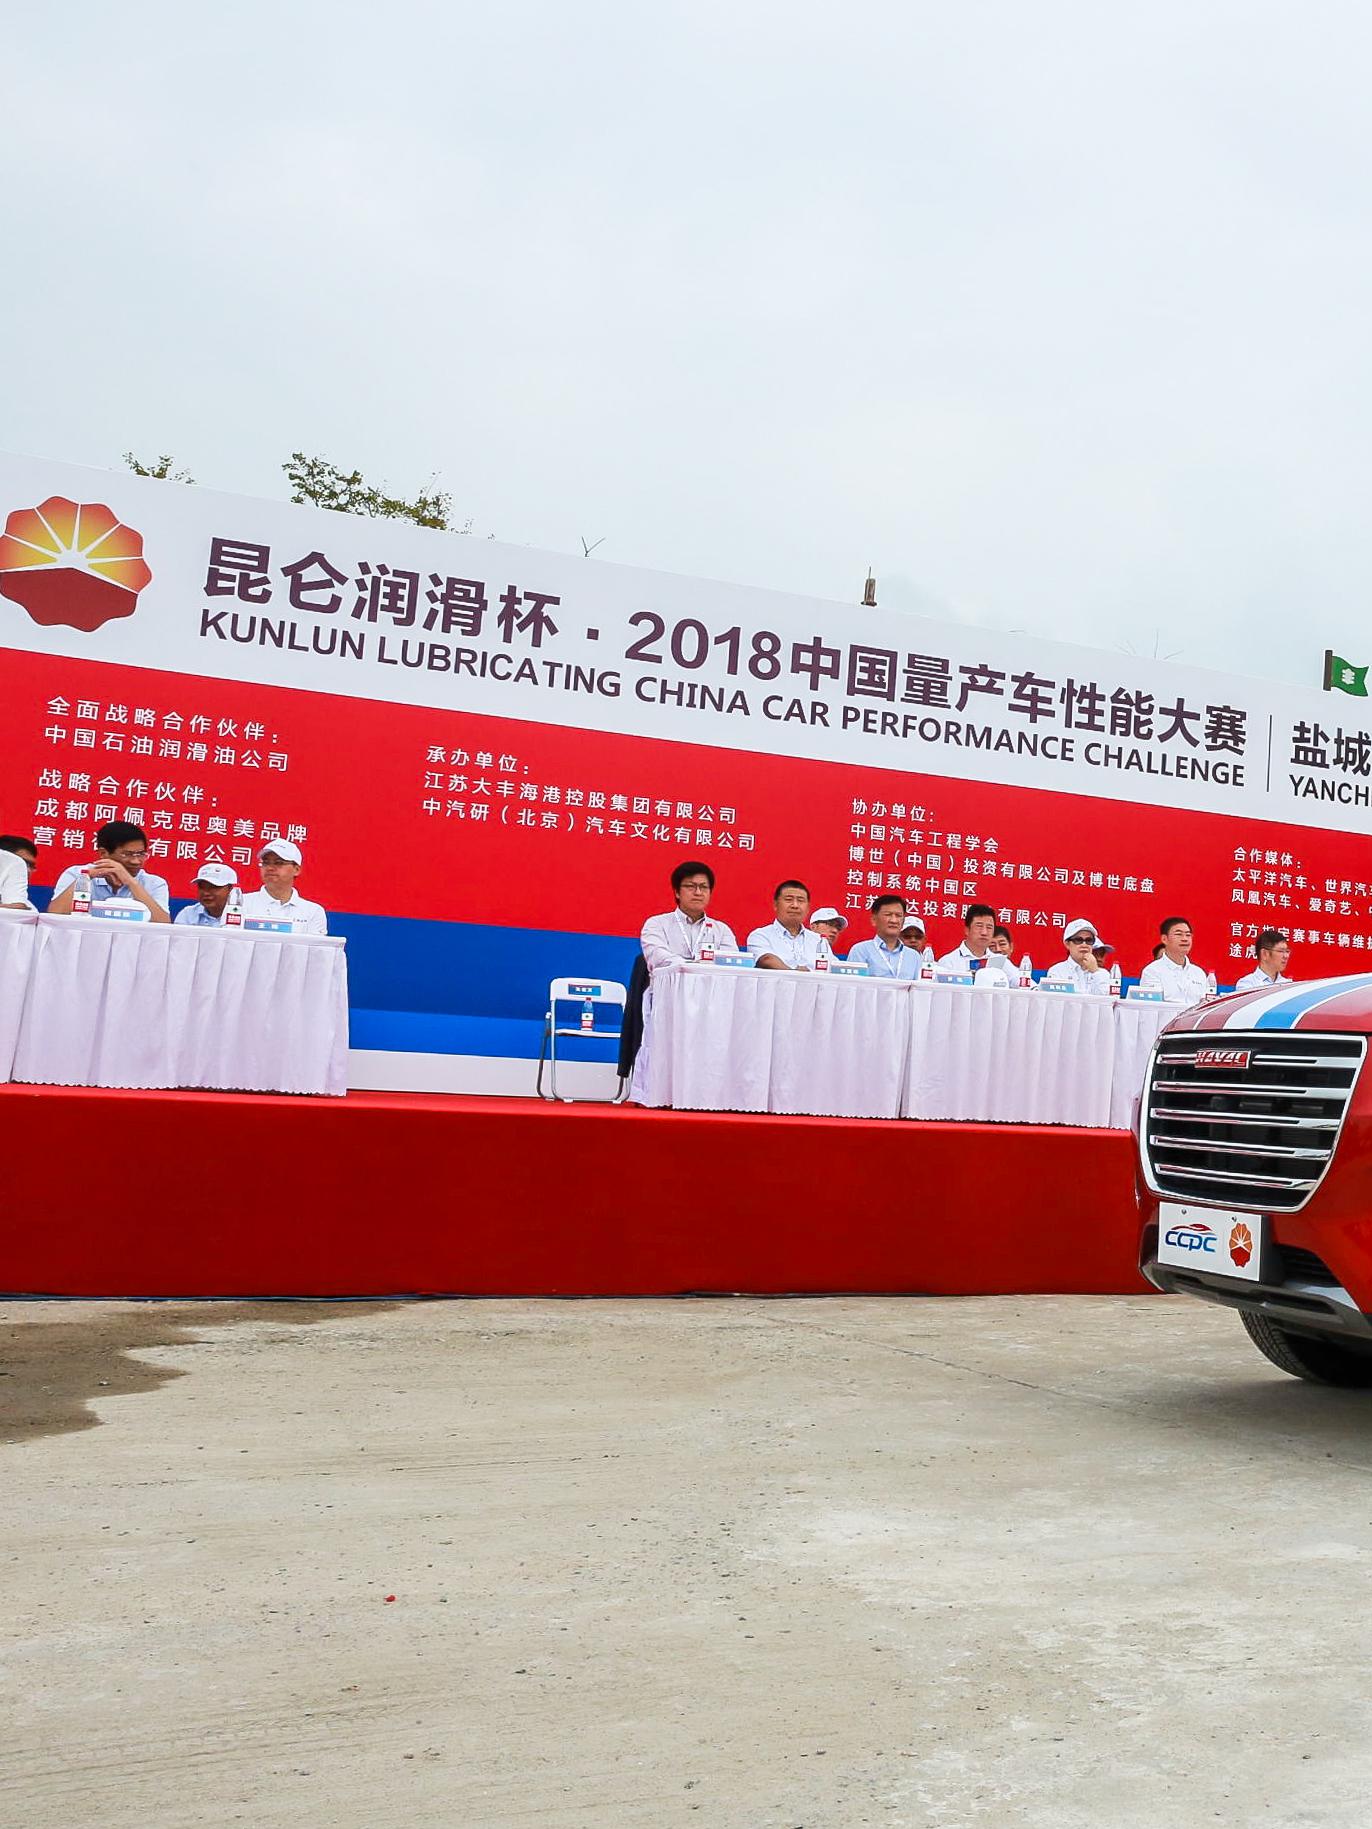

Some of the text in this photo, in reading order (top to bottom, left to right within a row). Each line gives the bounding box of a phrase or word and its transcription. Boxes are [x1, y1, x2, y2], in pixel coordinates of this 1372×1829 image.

[200, 609, 1245, 787] KUNLUN LUBRICATING CHINA CAR PERFORMANCE CHALLENGE
[47, 696, 279, 744] 全面战略合作伙伴：
[44, 725, 288, 772] 中国石油润滑油公司
[426, 745, 529, 775] 承办单位：
[38, 768, 218, 807] 战略合作伙伴：
[424, 771, 737, 824] 江苏大丰海港控股集团有限公司
[34, 797, 308, 843] 成都阿佩克思奥美品牌
[422, 798, 756, 850] 中汽研（北京）汽车文化有限公司
[852, 799, 934, 823] 协办单位：
[32, 825, 252, 866] 营销有限公司
[850, 823, 999, 854] 中国汽车工程学会
[1234, 846, 1302, 869] 合作媒体：
[847, 869, 977, 897] 控制系统中国区
[848, 845, 1155, 893] 博世（中国）投资有限公司及博世底盘
